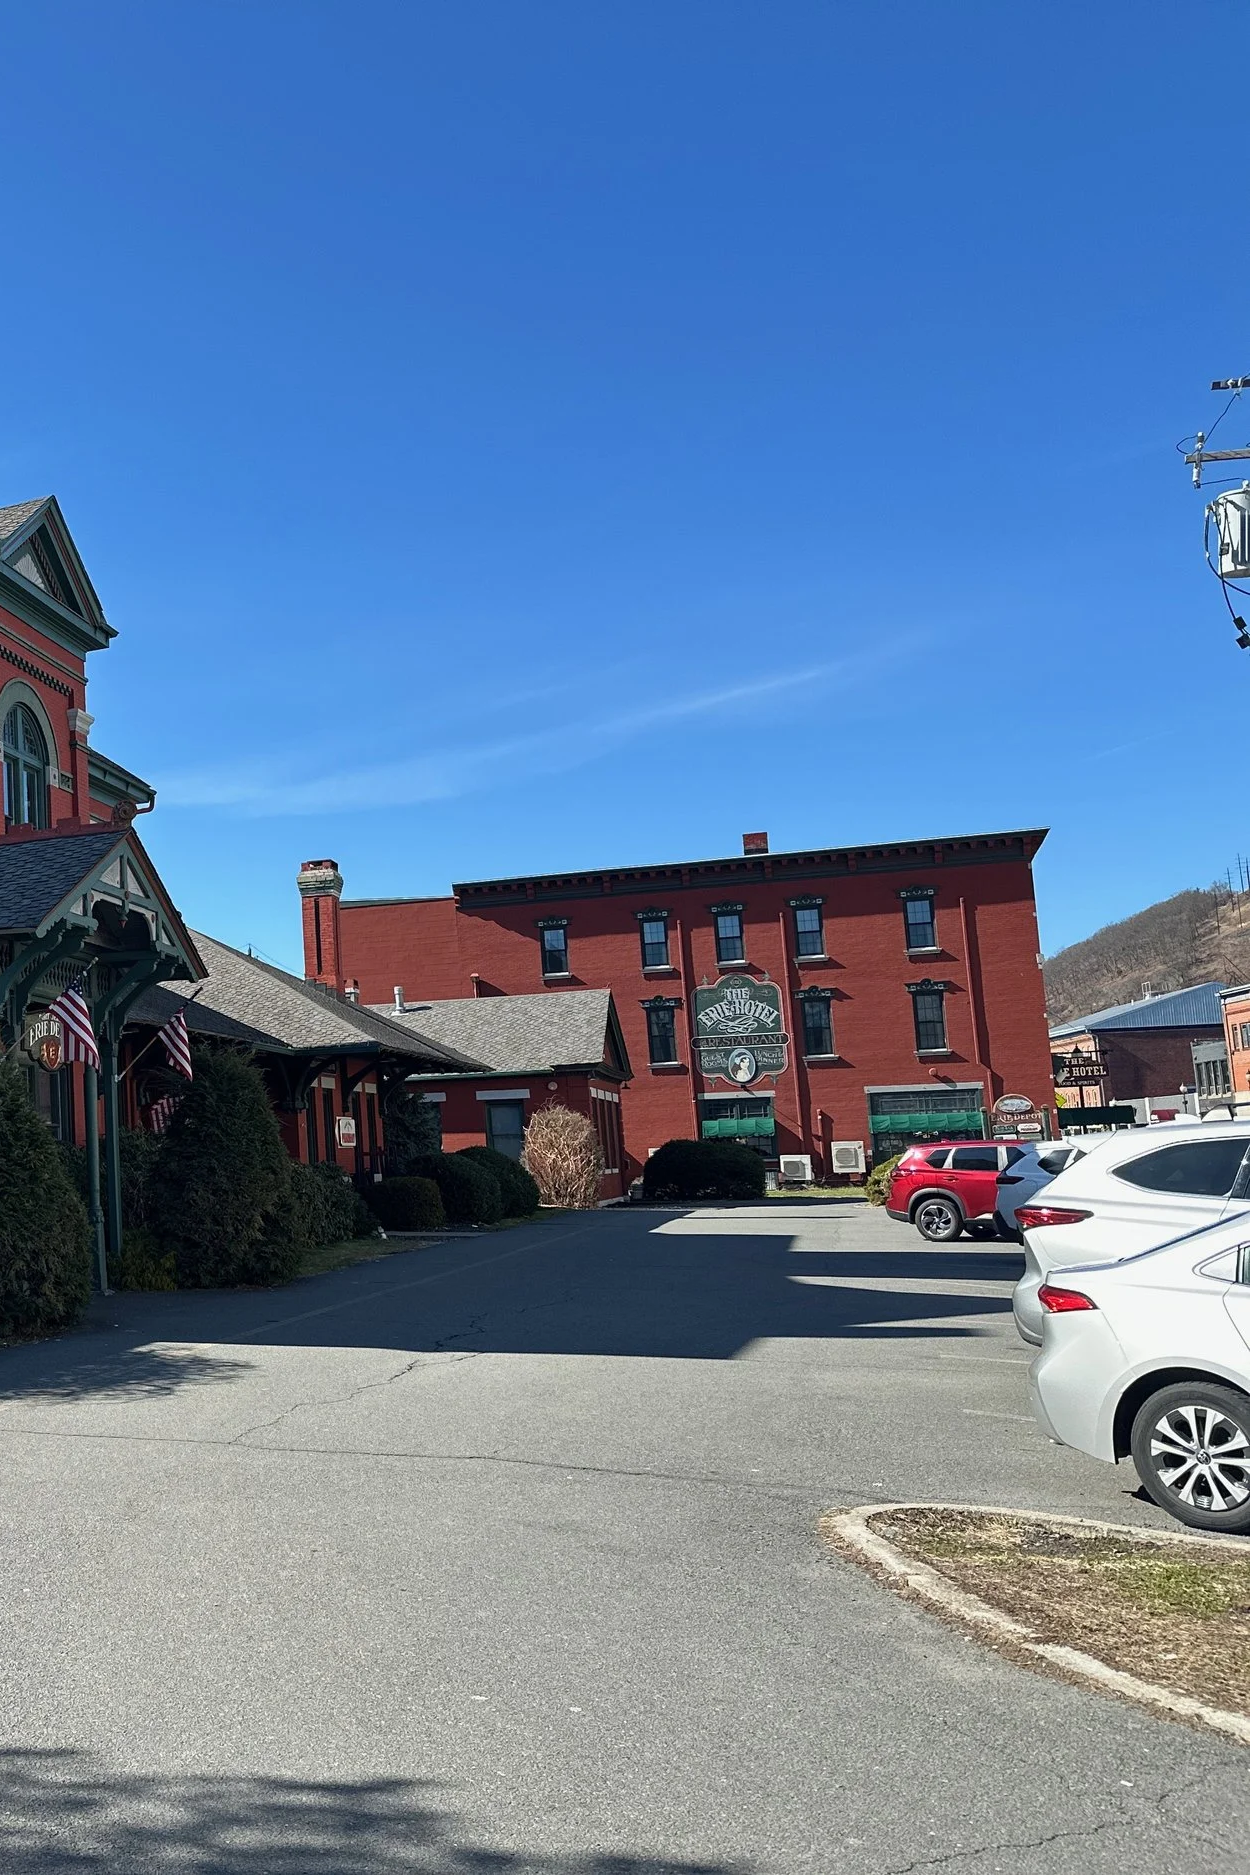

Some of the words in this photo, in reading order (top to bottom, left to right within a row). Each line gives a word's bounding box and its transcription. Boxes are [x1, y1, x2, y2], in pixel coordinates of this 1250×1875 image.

[723, 987, 750, 1001] THE
[697, 1001, 733, 1031] ERIE
[731, 1000, 780, 1027] HOTEL
[30, 1021, 48, 1046] ERIE
[709, 1034, 784, 1047] RESTAURANT
[754, 1050, 777, 1059] LUNCH
[1072, 1066, 1106, 1077] HOTEL
[1014, 1111, 1042, 1121] DEPOT
